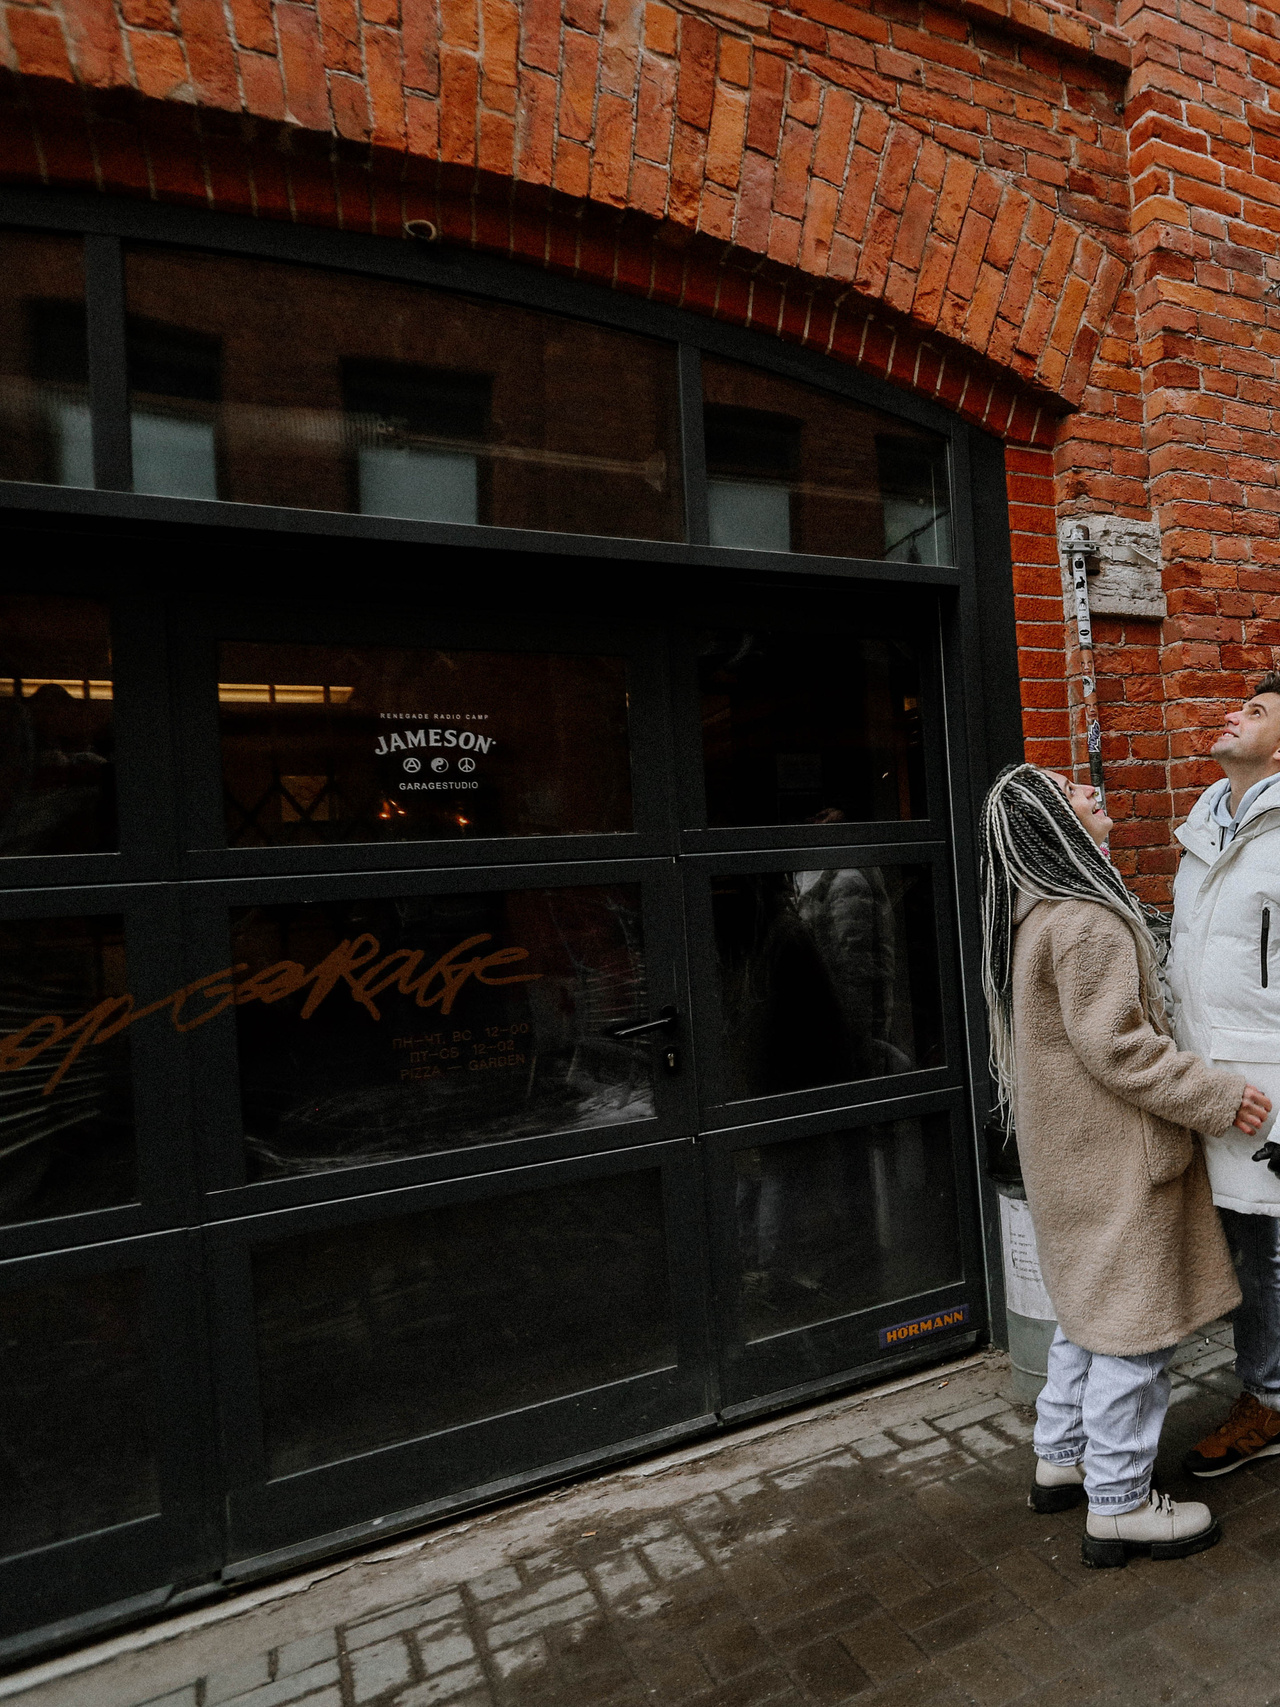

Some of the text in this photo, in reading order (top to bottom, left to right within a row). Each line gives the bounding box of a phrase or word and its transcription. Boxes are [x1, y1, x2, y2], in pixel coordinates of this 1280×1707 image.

[374, 728, 492, 755] JAMESON
[398, 781, 479, 791] GARAGESTUDIO
[452, 1029, 472, 1042] ВС
[400, 1065, 442, 1080] PIZZA
[468, 1053, 526, 1071] GARDEN
[886, 1310, 964, 1343] HÖRMANN
